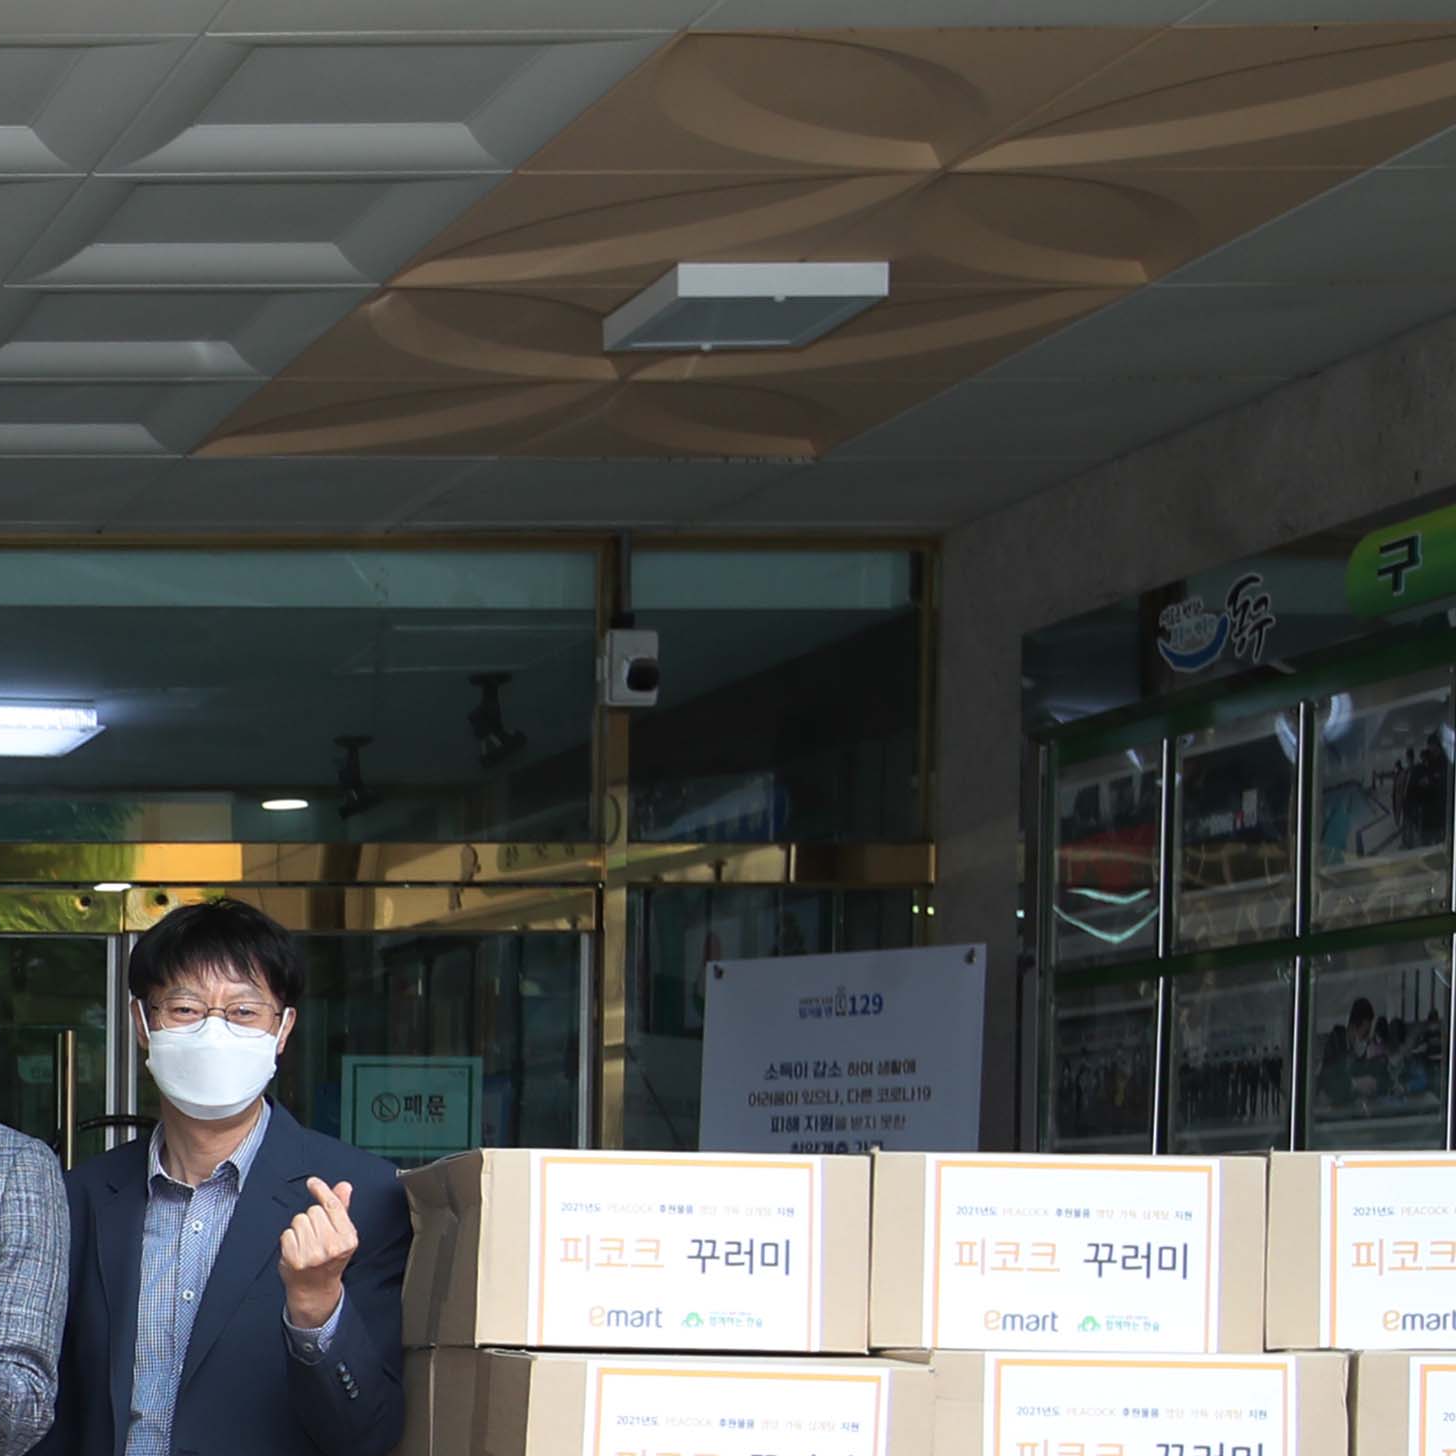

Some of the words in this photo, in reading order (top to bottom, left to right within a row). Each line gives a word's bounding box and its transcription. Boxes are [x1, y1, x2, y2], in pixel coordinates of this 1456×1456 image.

[1376, 530, 1423, 596] 구
[848, 993, 884, 1016] 129
[813, 1061, 841, 1078] 감소
[878, 1085, 932, 1102] 코로나19
[771, 1115, 799, 1133] 피해
[561, 1236, 664, 1269] 피코크
[686, 1238, 790, 1276] 꾸러미
[955, 1240, 1059, 1274] 피코크
[1083, 1241, 1188, 1280] 꾸러미
[590, 1304, 663, 1328] emart
[983, 1308, 1059, 1332] emart
